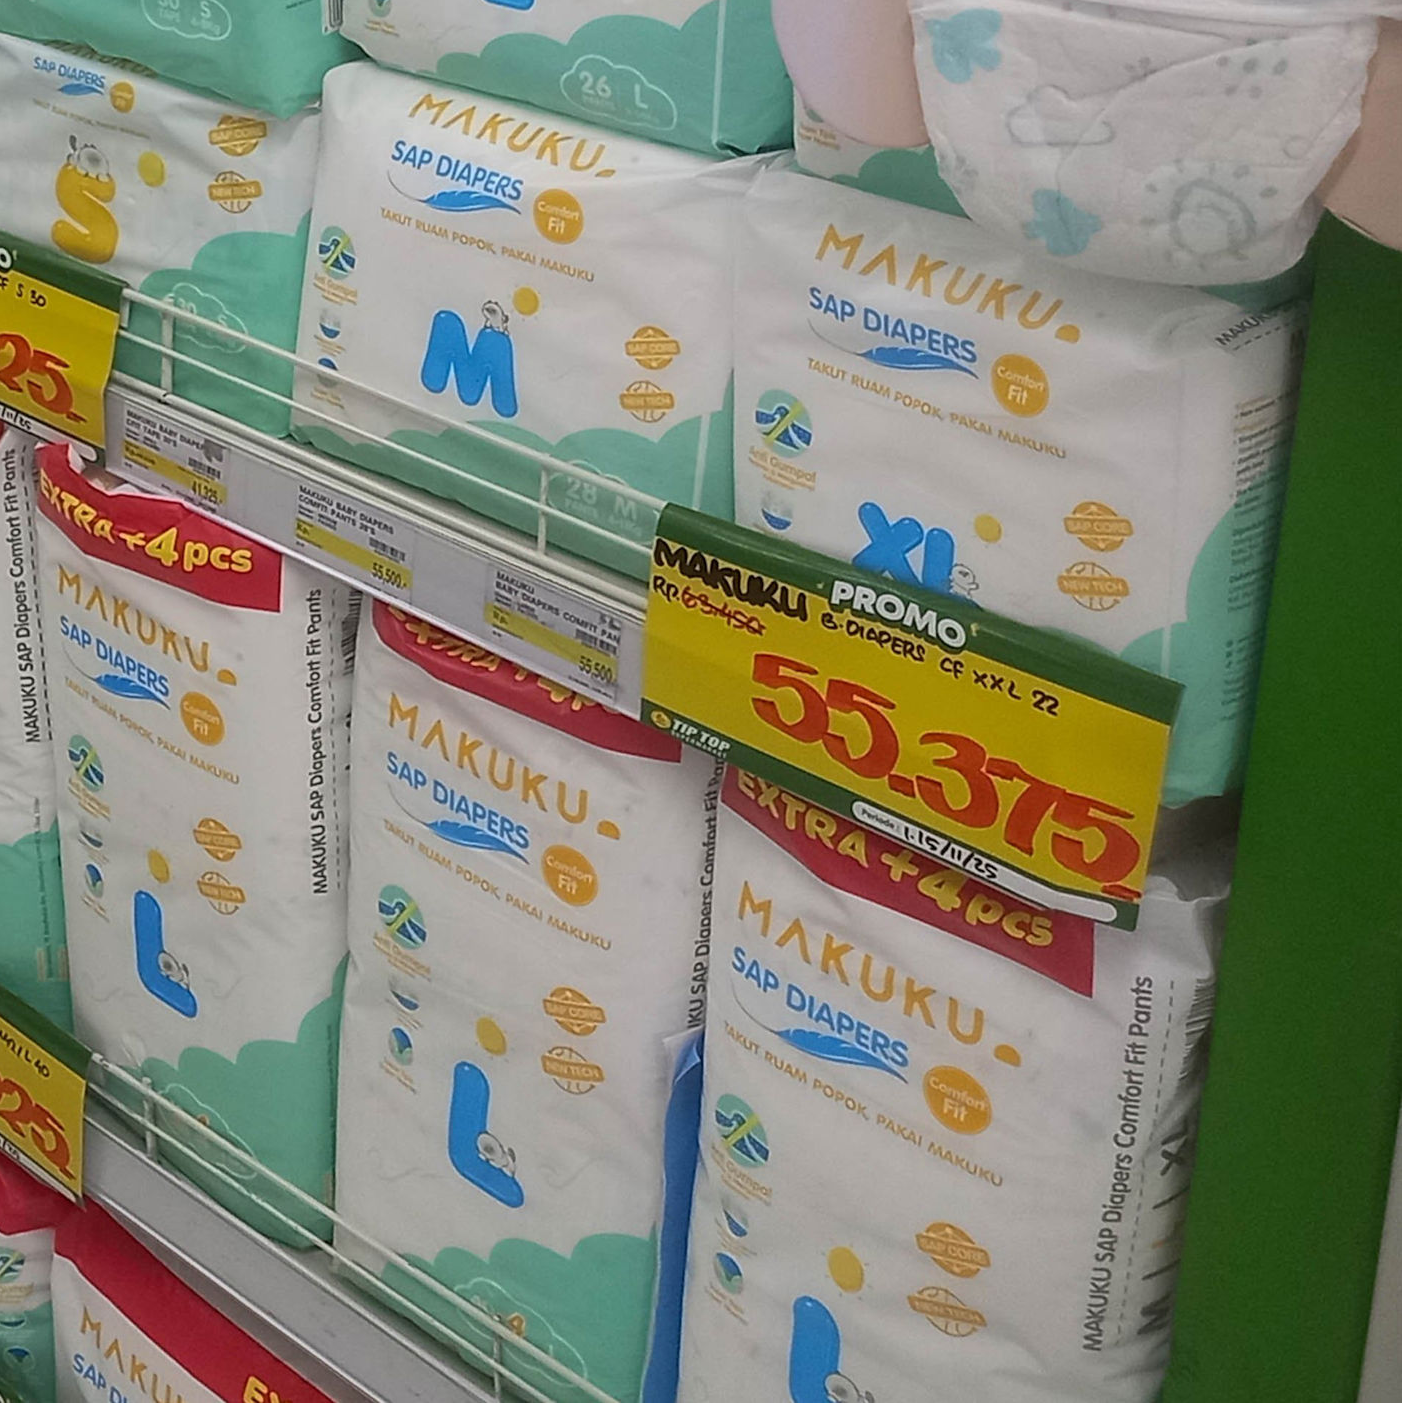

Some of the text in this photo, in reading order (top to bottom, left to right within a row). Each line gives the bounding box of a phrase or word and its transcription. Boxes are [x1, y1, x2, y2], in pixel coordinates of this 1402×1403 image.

[408, 94, 605, 174] MAKUKU
[579, 71, 612, 99] 26
[51, 162, 120, 265] S
[808, 286, 979, 364] SAP DIAPERS
[815, 223, 1063, 331] MAKUKU
[420, 310, 519, 419] M
[997, 366, 1045, 393] Comfort
[1006, 385, 1029, 407] Fit
[58, 563, 211, 675] MAKUKU
[653, 537, 1061, 717] MAKUKU CF XXL 22
[829, 580, 968, 649] PROMO
[388, 692, 592, 828] MAKUKU
[672, 718, 731, 755] TIP TOP
[385, 752, 531, 852] SAP DIAPERS
[736, 768, 868, 868] EXTRA
[133, 889, 198, 1019] L
[736, 881, 986, 1047] MAKUKU
[732, 947, 910, 1070] SAP DIAPERS
[448, 1060, 526, 1210] L
[723, 1020, 760, 1057] TAKUT
[763, 1049, 809, 1087] RUAM
[875, 1112, 923, 1148] PAKAI
[927, 1138, 1005, 1189] MAKUKU
[928, 1073, 990, 1114] Comfort
[942, 1097, 969, 1124] Fit
[1083, 976, 1155, 1352] MAKUKU SAP Diapers Comfort Fit Pants
